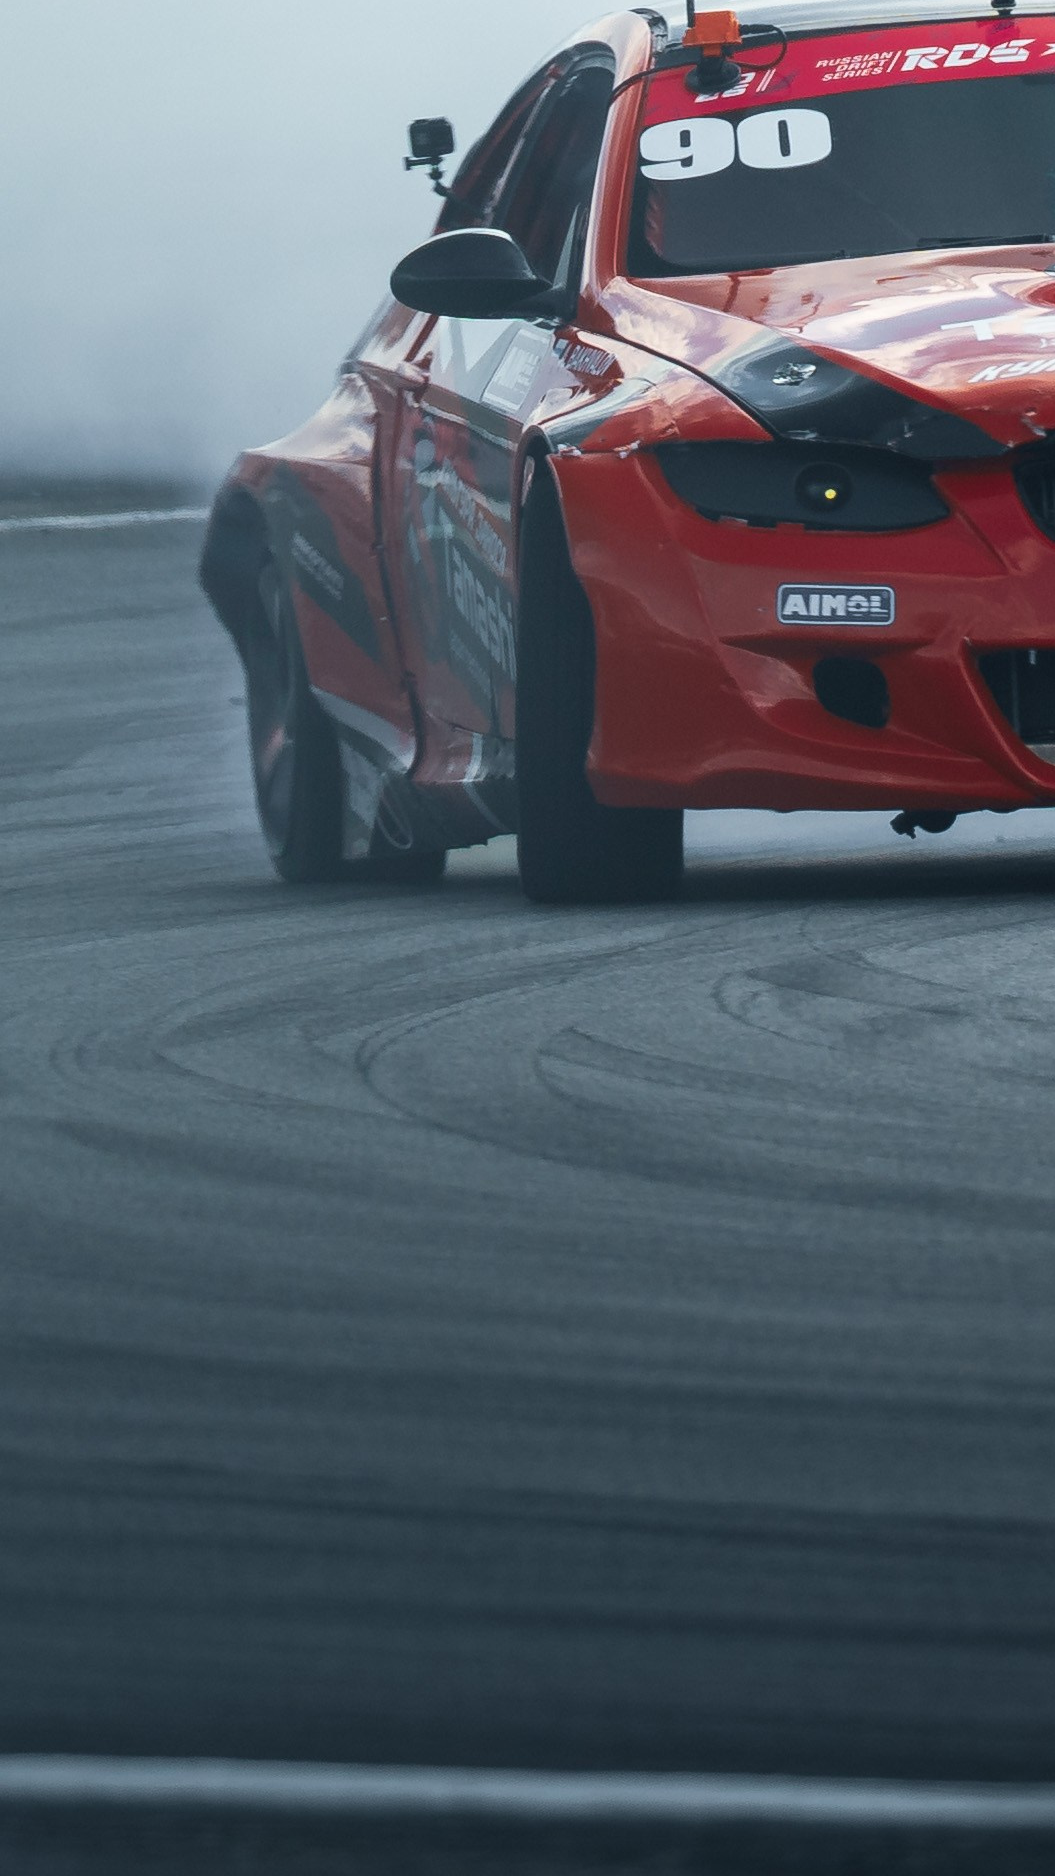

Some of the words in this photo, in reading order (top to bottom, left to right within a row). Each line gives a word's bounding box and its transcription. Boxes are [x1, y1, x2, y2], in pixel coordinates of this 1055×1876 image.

[815, 50, 894, 69] RUSSIAN
[901, 38, 1036, 72] RDS
[822, 66, 884, 83] SERIES
[835, 59, 890, 73] DRIFT
[639, 108, 832, 181] 90
[782, 593, 889, 617] AIMOL
